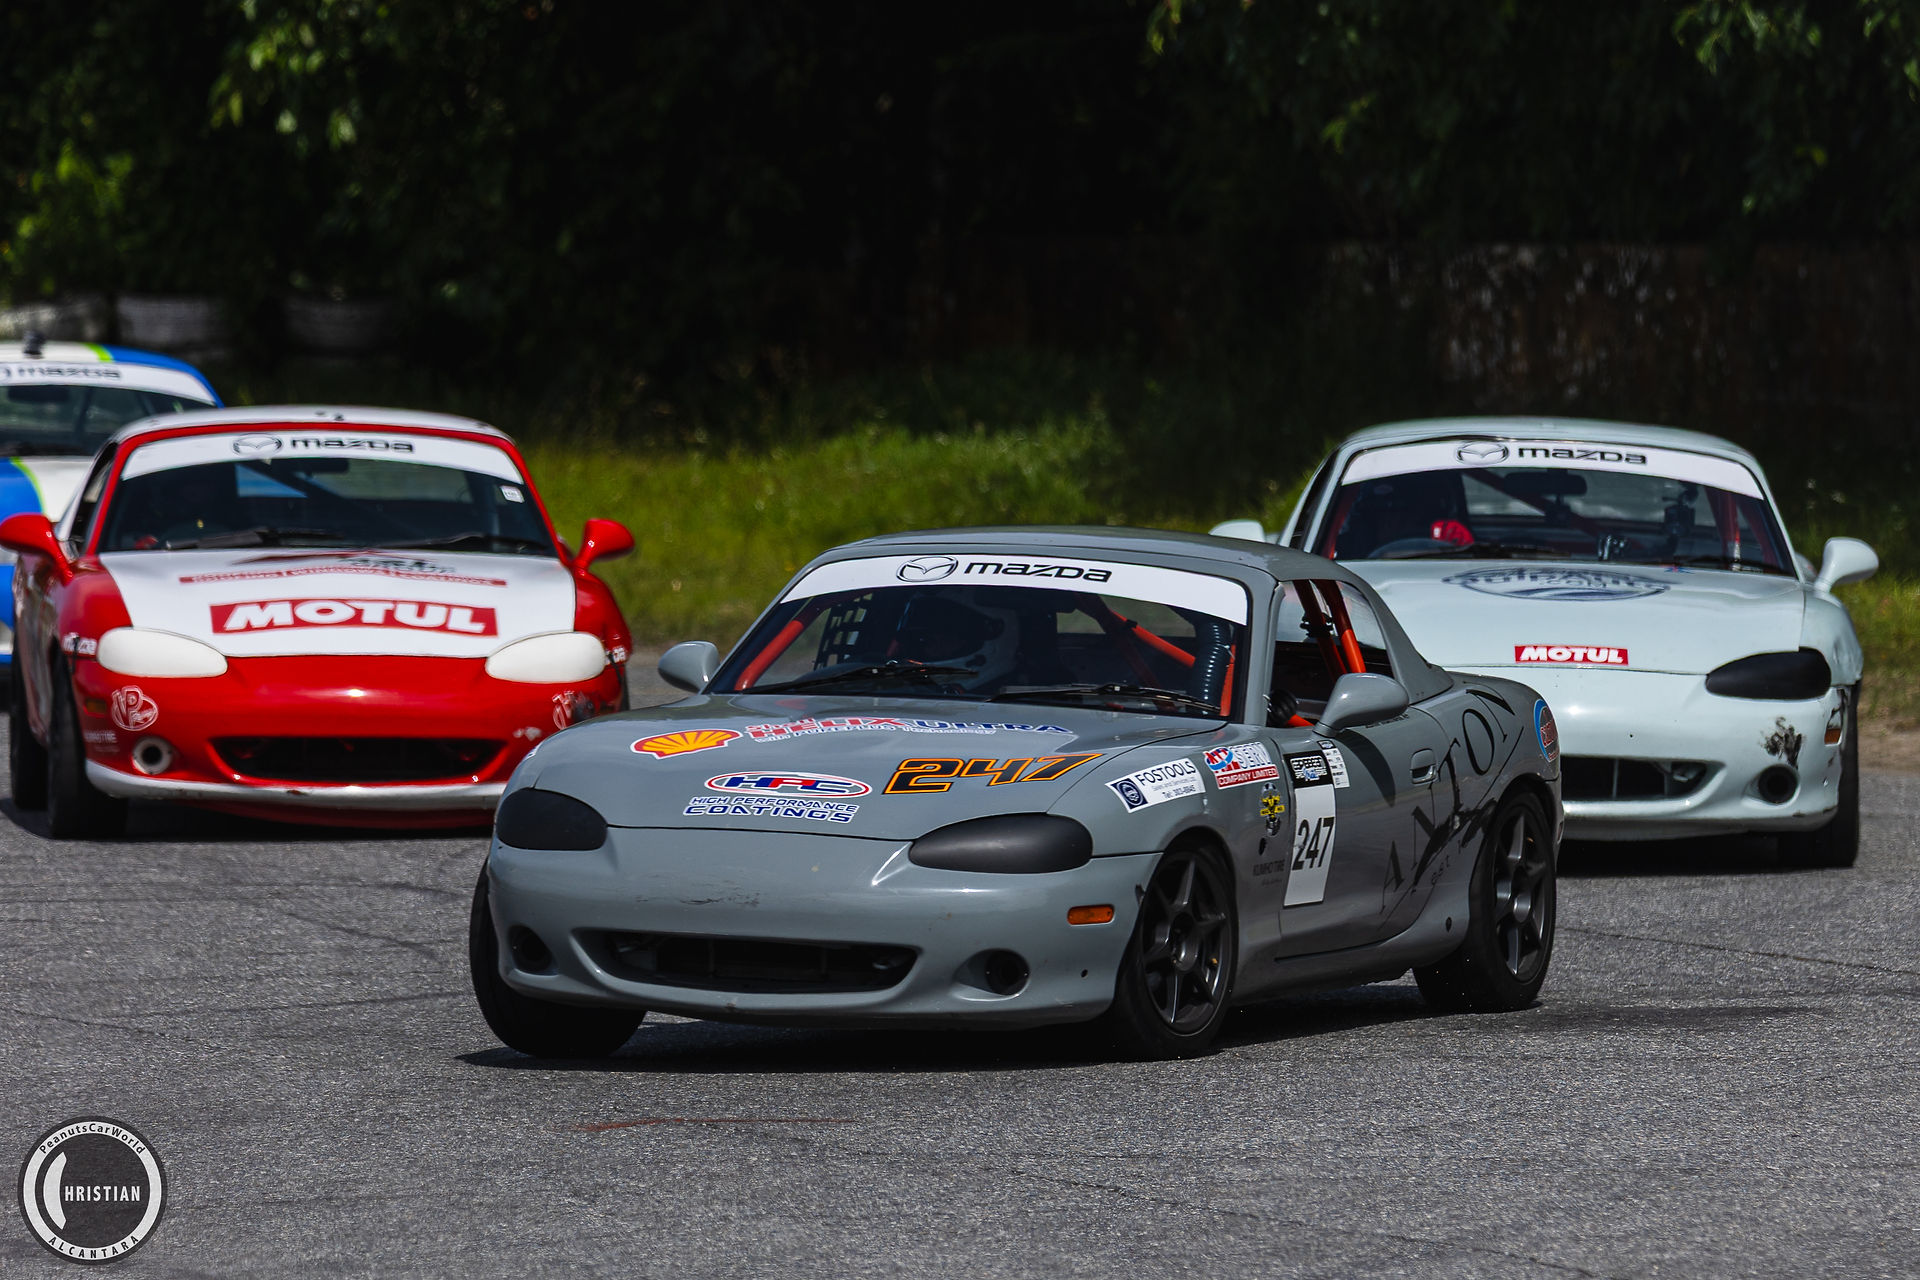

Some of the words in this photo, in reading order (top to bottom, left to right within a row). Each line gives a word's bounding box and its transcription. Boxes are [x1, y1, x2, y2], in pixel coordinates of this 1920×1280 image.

[291, 438, 414, 453] mazda
[1518, 447, 1647, 465] mazda
[964, 562, 1112, 583] mazda
[224, 599, 487, 633] MOTUL
[1520, 646, 1624, 664] MOTUL
[747, 717, 907, 739] HELIX
[914, 719, 1073, 733] ULTRA
[882, 753, 1106, 795] 247
[1135, 760, 1196, 786] FOSTOOLS
[1218, 772, 1252, 785] COMPANY
[1252, 767, 1278, 779] LIMITED
[684, 804, 853, 823] COATINGS
[692, 796, 729, 804] HIGH
[733, 796, 858, 813] PERFORMANCE
[1292, 816, 1335, 871] 247
